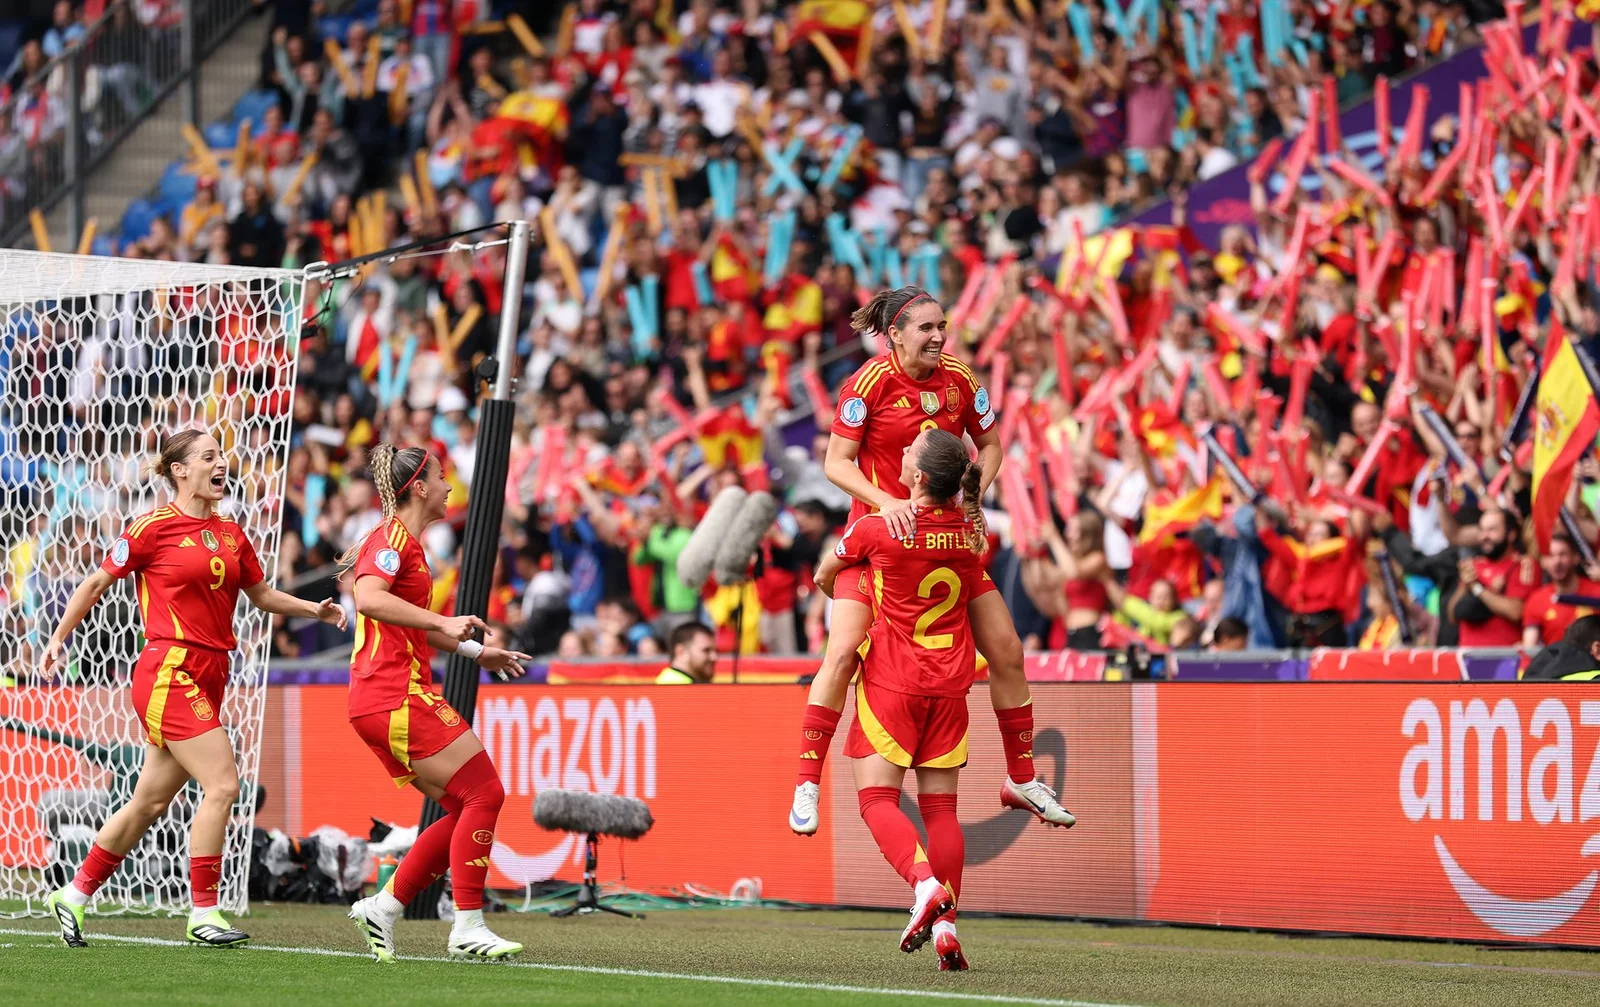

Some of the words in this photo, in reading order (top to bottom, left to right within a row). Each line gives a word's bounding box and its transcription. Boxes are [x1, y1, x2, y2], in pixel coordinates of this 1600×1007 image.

[925, 532, 976, 550] BATLL
[209, 556, 226, 590] 9
[913, 566, 962, 650] 2
[175, 670, 201, 699] 9
[472, 695, 657, 799] mazon
